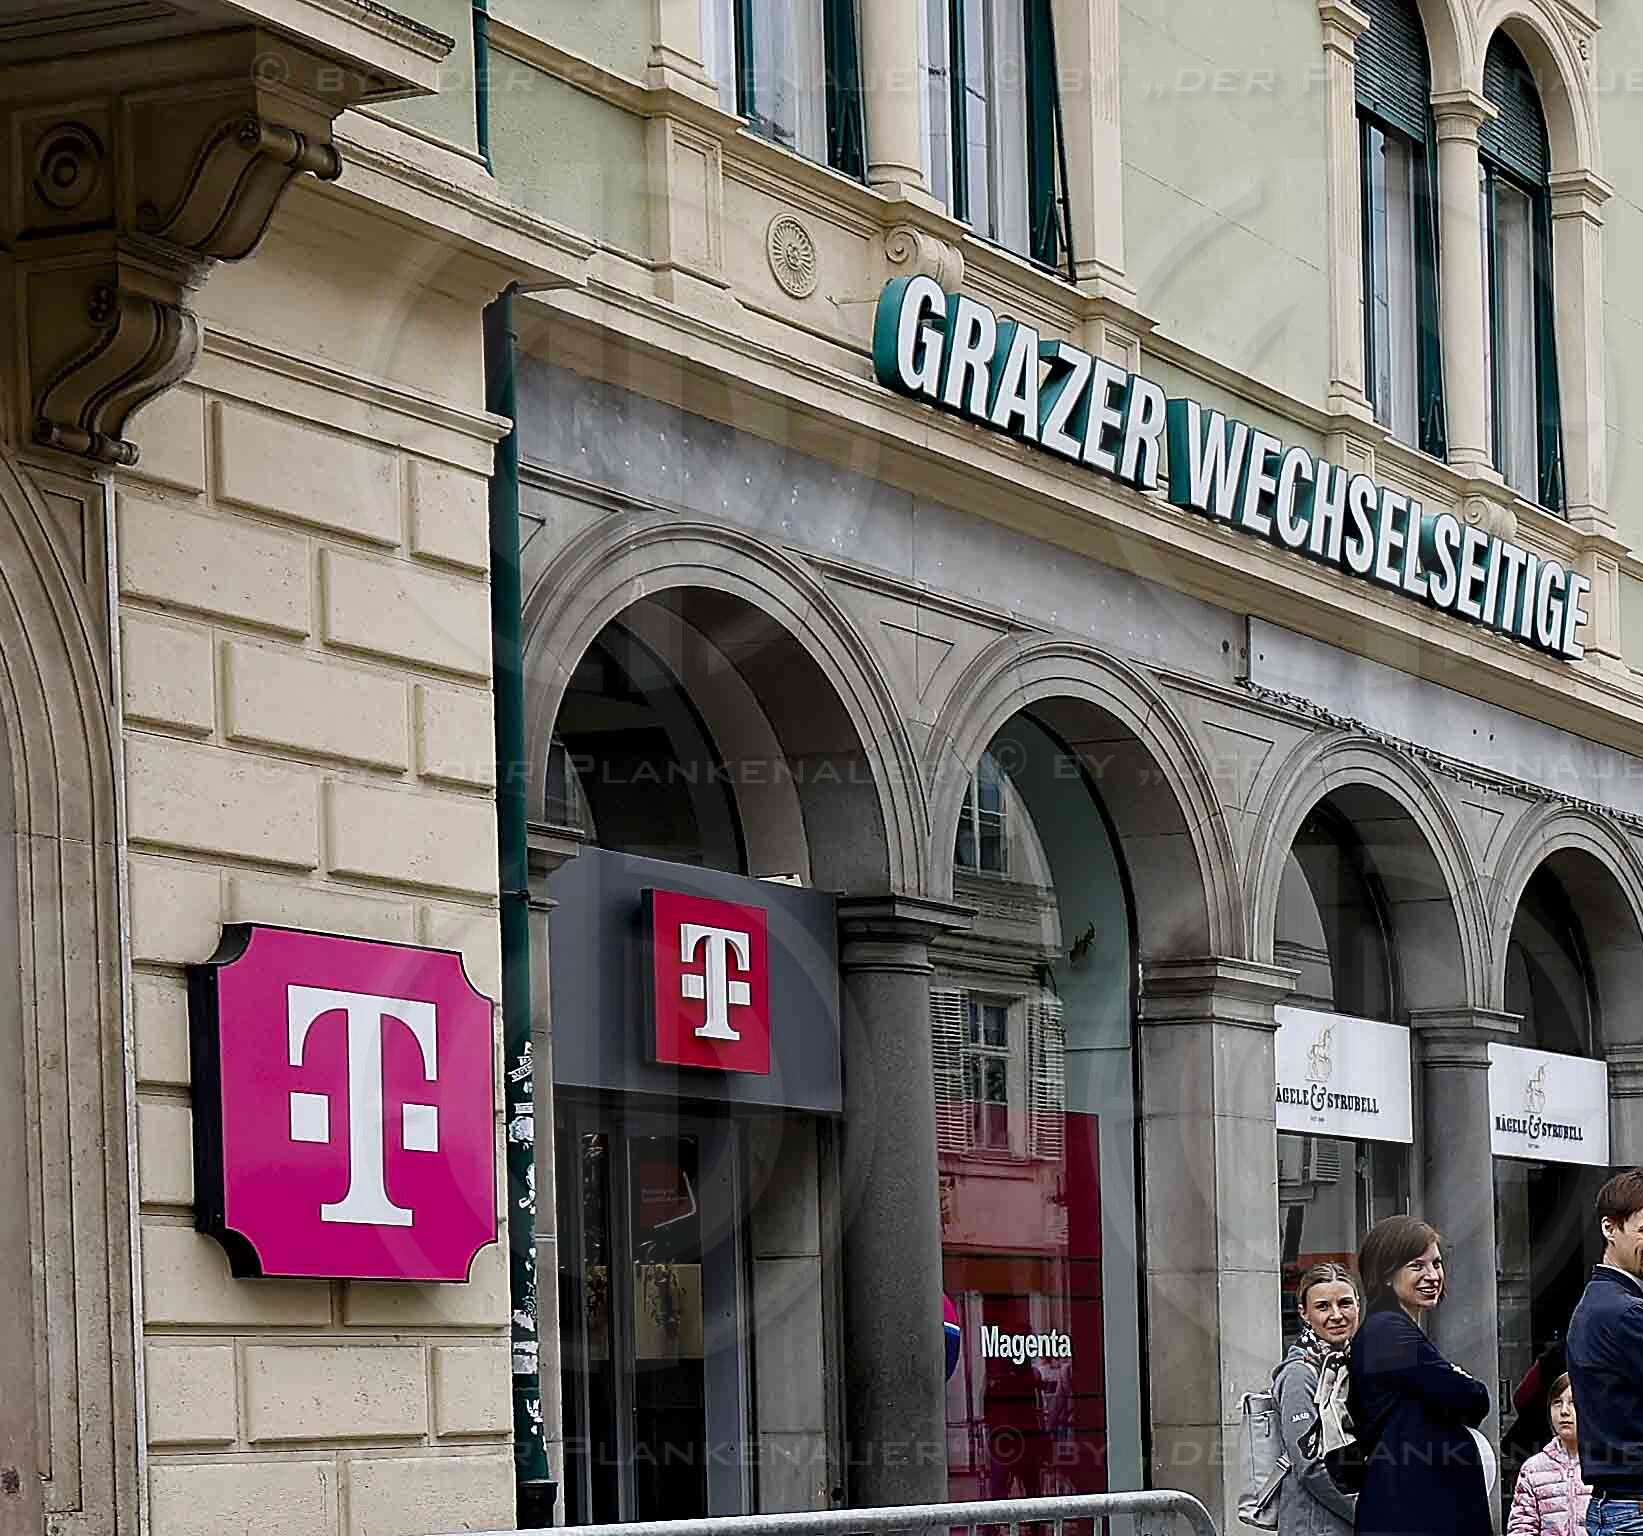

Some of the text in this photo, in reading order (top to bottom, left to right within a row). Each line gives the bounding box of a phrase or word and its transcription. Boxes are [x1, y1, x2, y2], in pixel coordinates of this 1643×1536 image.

[893, 273, 1593, 661] GRAZER WECHSELSEITIGE
[1276, 1083, 1380, 1114] ÄGELE & STRUBELL
[1495, 1114, 1584, 1142] NÄGELE & STRUBELL
[981, 1325, 1072, 1365] Magenta
